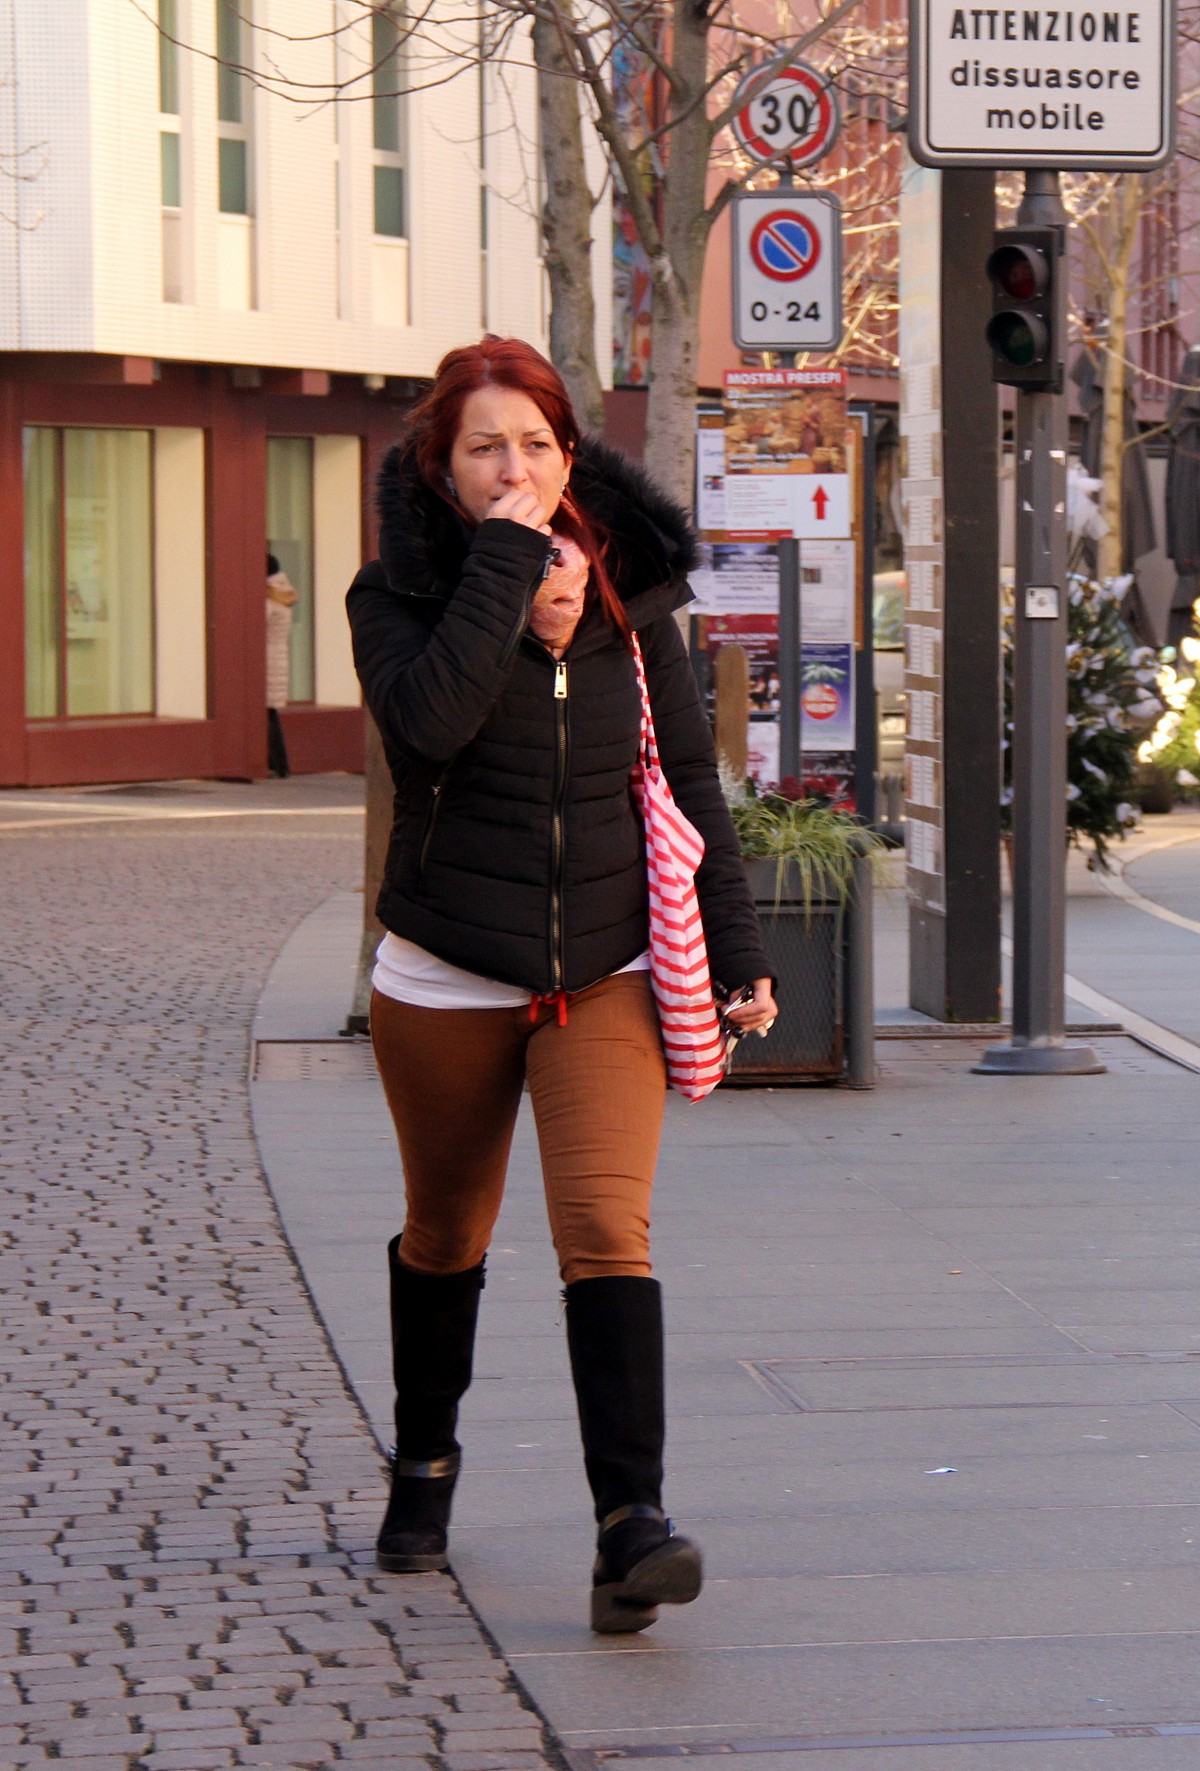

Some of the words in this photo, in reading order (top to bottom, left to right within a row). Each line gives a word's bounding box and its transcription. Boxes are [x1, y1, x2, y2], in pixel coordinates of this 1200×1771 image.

[950, 9, 1142, 43] ATTENZIONE
[950, 60, 1141, 89] dissuasore
[761, 94, 810, 136] 30
[986, 103, 1105, 131] mobile
[728, 373, 784, 384] MOSTRA
[788, 372, 842, 384] PRESEPI
